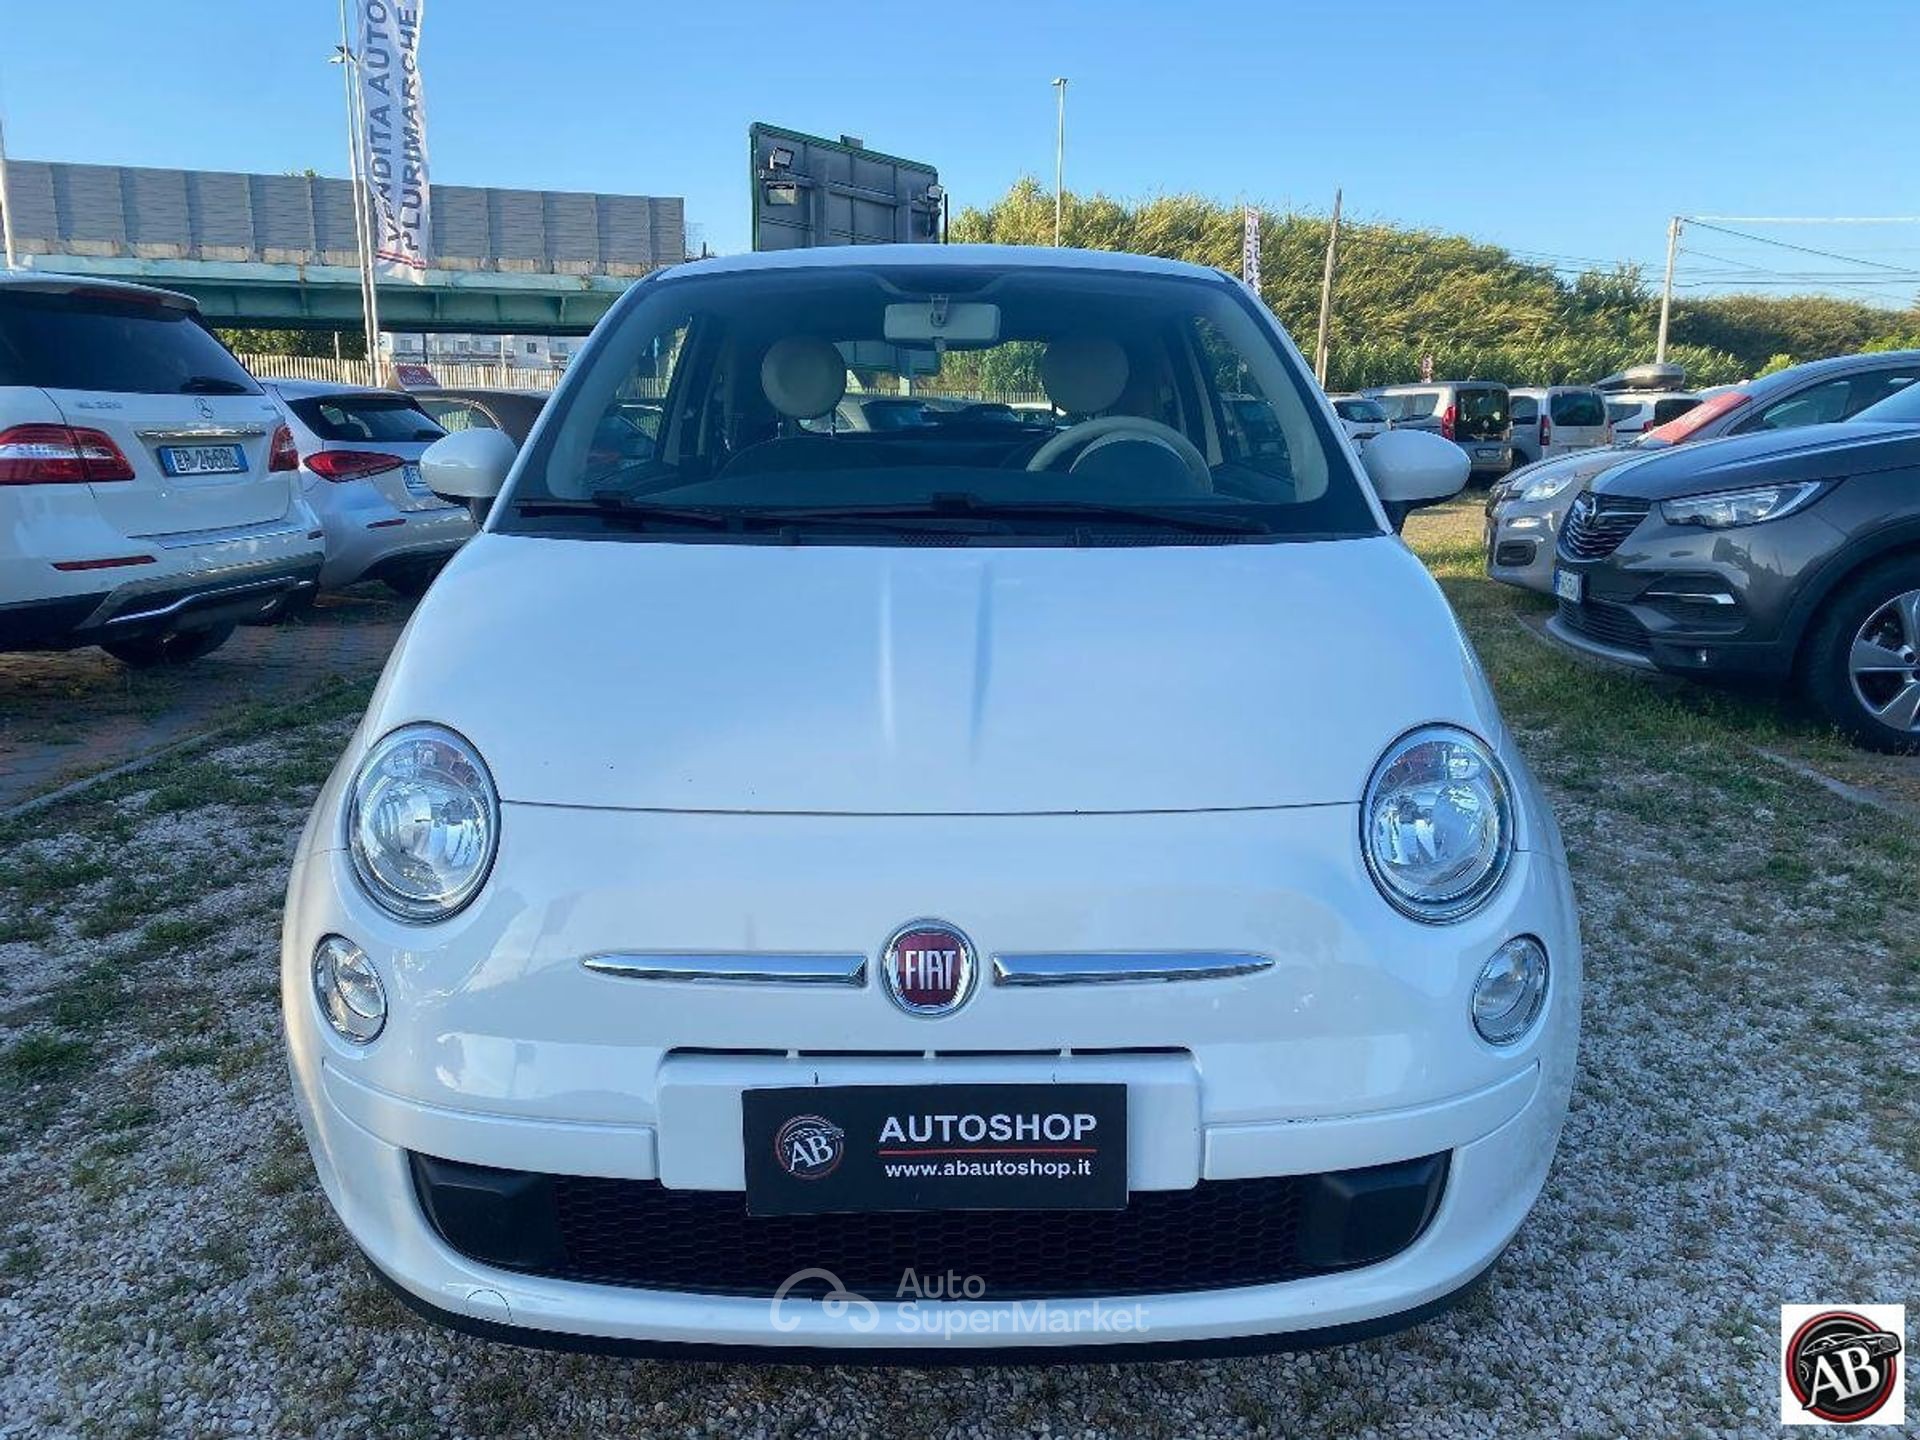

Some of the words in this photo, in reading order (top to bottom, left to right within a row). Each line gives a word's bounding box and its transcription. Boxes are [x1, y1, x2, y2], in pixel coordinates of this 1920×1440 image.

[367, 1, 390, 96] AUTO
[398, 7, 422, 250] PLURIMARCHE
[370, 104, 400, 241] VENDITA
[905, 950, 956, 990] FIAT
[880, 1114, 1096, 1143] AUTOSHOP
[788, 1137, 833, 1172] AB
[886, 1159, 1092, 1178] www.abautoshop.it
